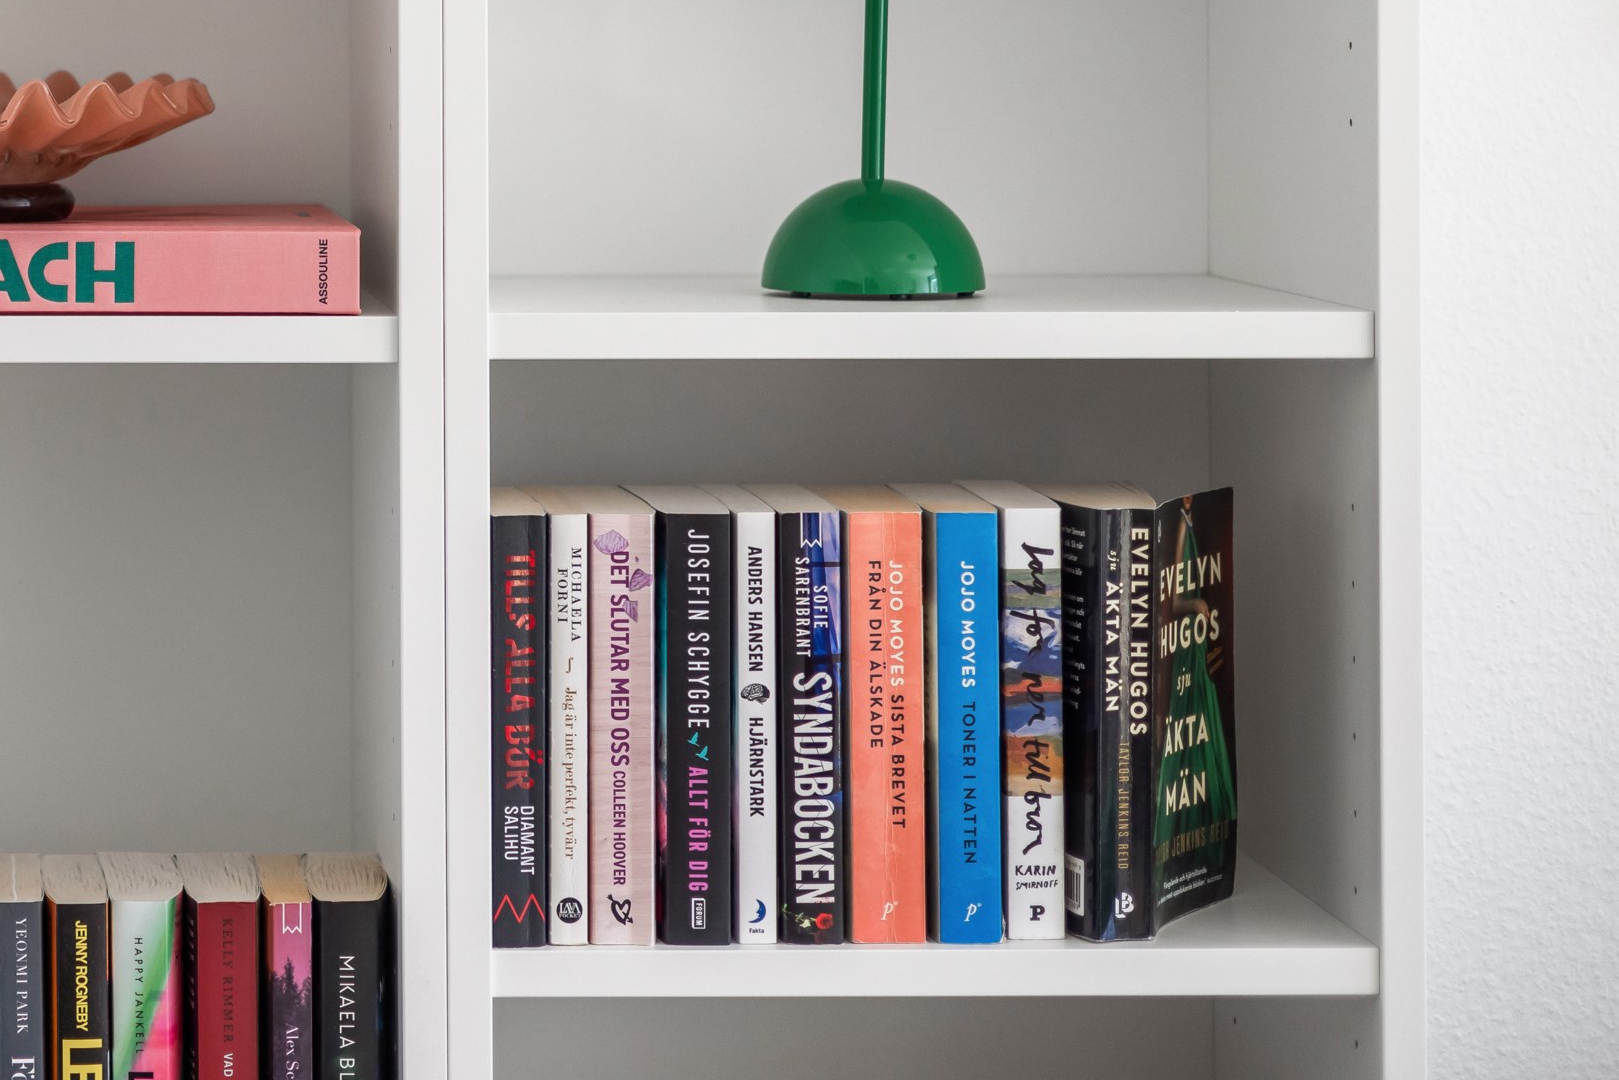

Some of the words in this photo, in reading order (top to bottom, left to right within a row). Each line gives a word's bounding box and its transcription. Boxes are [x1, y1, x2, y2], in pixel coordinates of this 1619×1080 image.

[318, 239, 330, 305] ASSOULINE
[557, 568, 568, 623] FORNI
[571, 547, 582, 642] MICHAELA
[611, 551, 630, 588] DET
[688, 529, 710, 620] JOSEFIN
[748, 546, 763, 605] ANDERS
[868, 560, 886, 610] FRÅN
[889, 560, 904, 611] JOJO
[1131, 528, 1150, 628] EVELYN
[1160, 553, 1222, 603] EVELYN
[610, 594, 630, 671] SLUTAR
[795, 557, 811, 657] SARENBRANT
[813, 585, 828, 629] SOFIE
[748, 612, 763, 671] HANSEN
[869, 620, 882, 651] DIN
[890, 620, 904, 687] MOYES
[1160, 609, 1220, 659] HUGOS
[562, 687, 577, 710] Jag
[610, 679, 630, 721] MED
[688, 632, 710, 728] SCHYGGE
[869, 661, 887, 748] ÄLSKADE
[1130, 642, 1149, 735] HUGOS
[564, 714, 577, 730] är
[565, 733, 577, 759] inte
[890, 694, 905, 746] SISTA
[1165, 712, 1209, 757] ÄKTA
[611, 728, 630, 766] OSS
[749, 717, 768, 817] HJÄRNSTARK
[562, 762, 577, 814] perfekt,
[613, 770, 626, 828] COLLEEN
[689, 767, 708, 809] ALLT
[793, 672, 835, 904] SYNDABOCKEN
[891, 755, 906, 828] BREVET
[1165, 769, 1207, 816] MÄN
[504, 806, 519, 861] SALIHU
[520, 806, 535, 875] DIAMANT
[562, 817, 577, 859] tyvärr
[613, 832, 626, 886] HOOVER
[689, 818, 711, 851] FÖR
[689, 861, 708, 891] DIG
[1015, 865, 1056, 876] KARIN
[1016, 880, 1059, 890] SMIRNOFF
[15, 918, 28, 984] YEONMI
[75, 921, 87, 966] JENNY
[134, 937, 143, 983] HAPPY
[222, 919, 233, 968] KELLY
[17, 991, 29, 1033] PARK
[75, 967, 88, 1031] ROGNEBY
[135, 992, 145, 1054] JANKELL
[223, 977, 234, 1043] RIMMER
[339, 956, 356, 1049] MIKAELA
[223, 1053, 234, 1077] VAD
[285, 1023, 300, 1055] Alex
